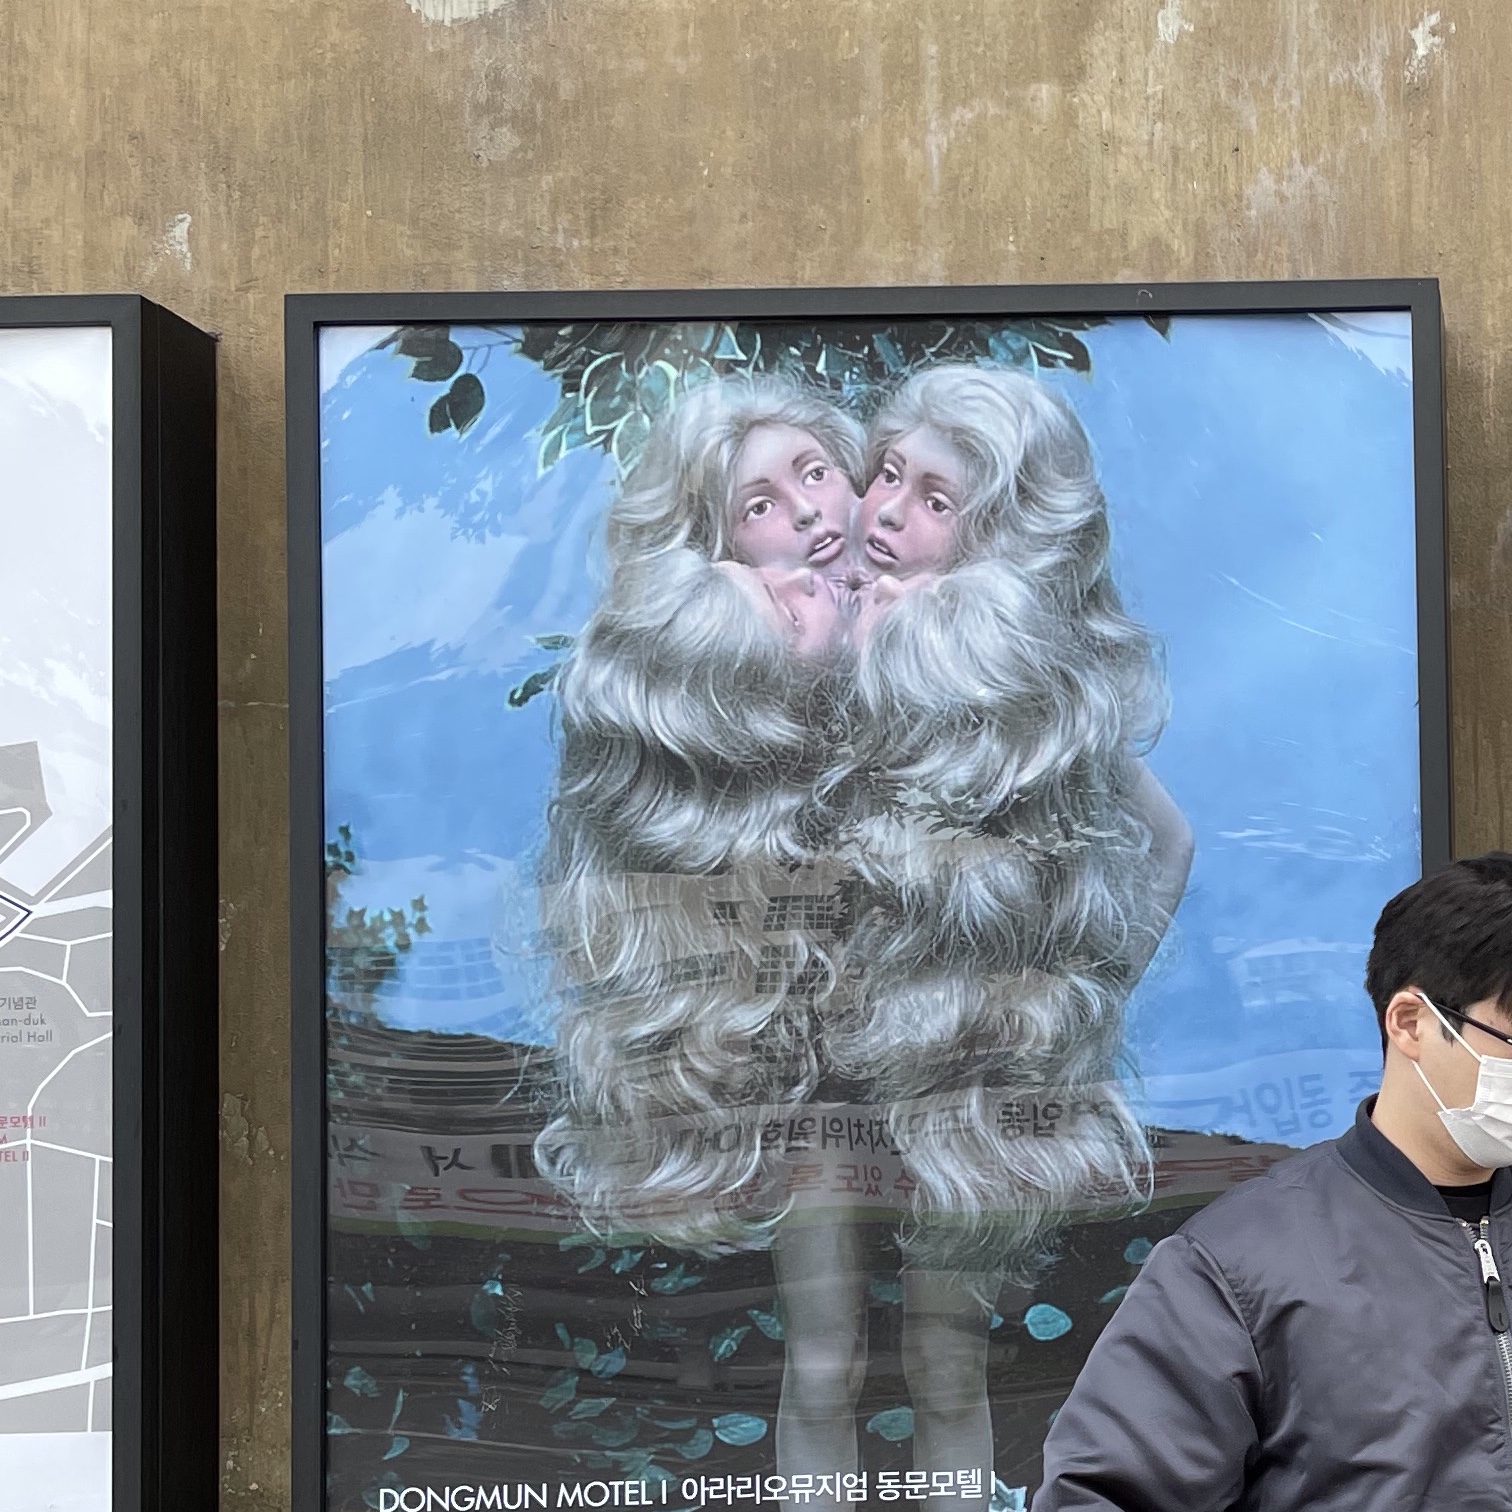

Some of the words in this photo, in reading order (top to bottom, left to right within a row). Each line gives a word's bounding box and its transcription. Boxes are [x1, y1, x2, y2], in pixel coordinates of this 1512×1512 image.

[0, 1013, 47, 1026] an-duk
[0, 1030, 23, 1043] rial
[27, 1029, 53, 1043] Hall
[556, 1480, 654, 1508] MOTEL
[682, 1471, 868, 1507] 아라리오뮤지엄
[876, 1469, 983, 1500] 동문모텔
